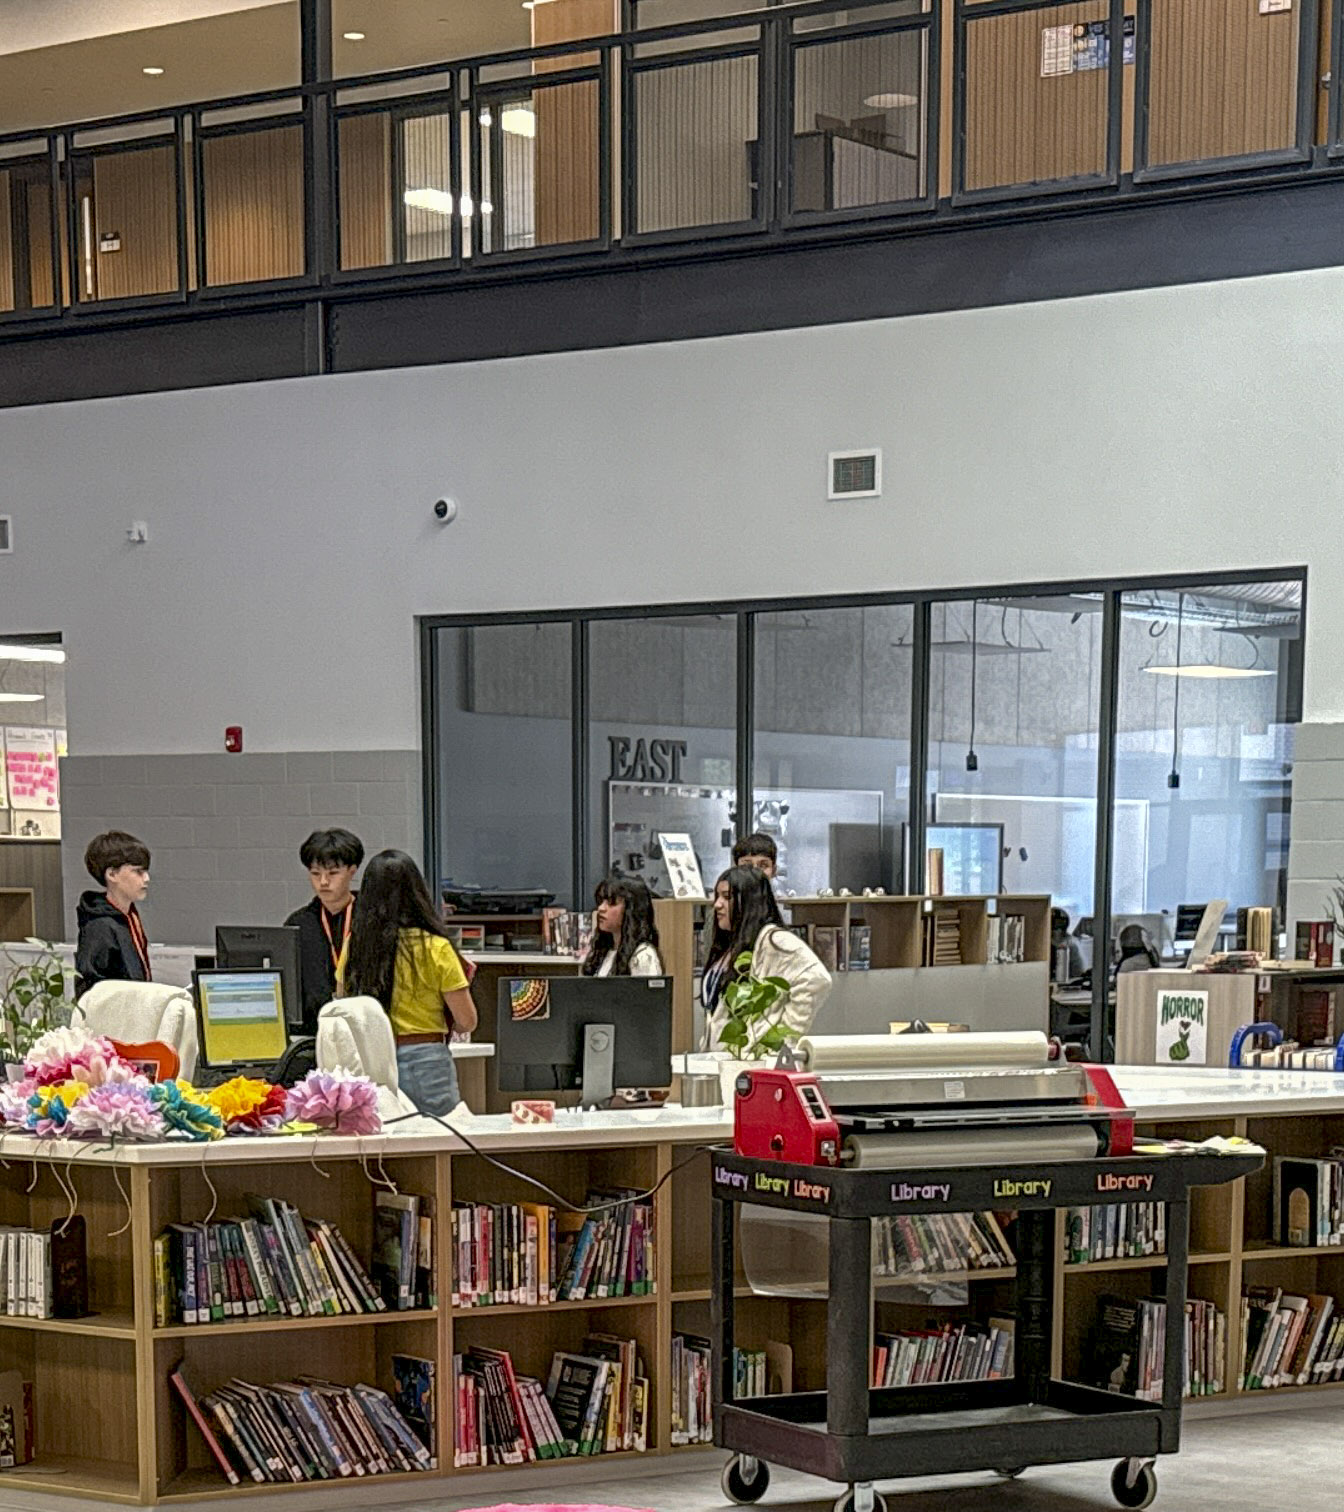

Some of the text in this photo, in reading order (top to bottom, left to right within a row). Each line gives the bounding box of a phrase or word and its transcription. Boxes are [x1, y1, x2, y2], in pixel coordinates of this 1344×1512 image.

[607, 736, 687, 783] EAST
[1161, 994, 1205, 1026] HORROR
[715, 1165, 749, 1192] Library
[754, 1172, 790, 1197] Library
[793, 1178, 830, 1203] Library
[891, 1181, 950, 1201] Library
[993, 1178, 1052, 1198] Library
[1096, 1172, 1154, 1192] Library
